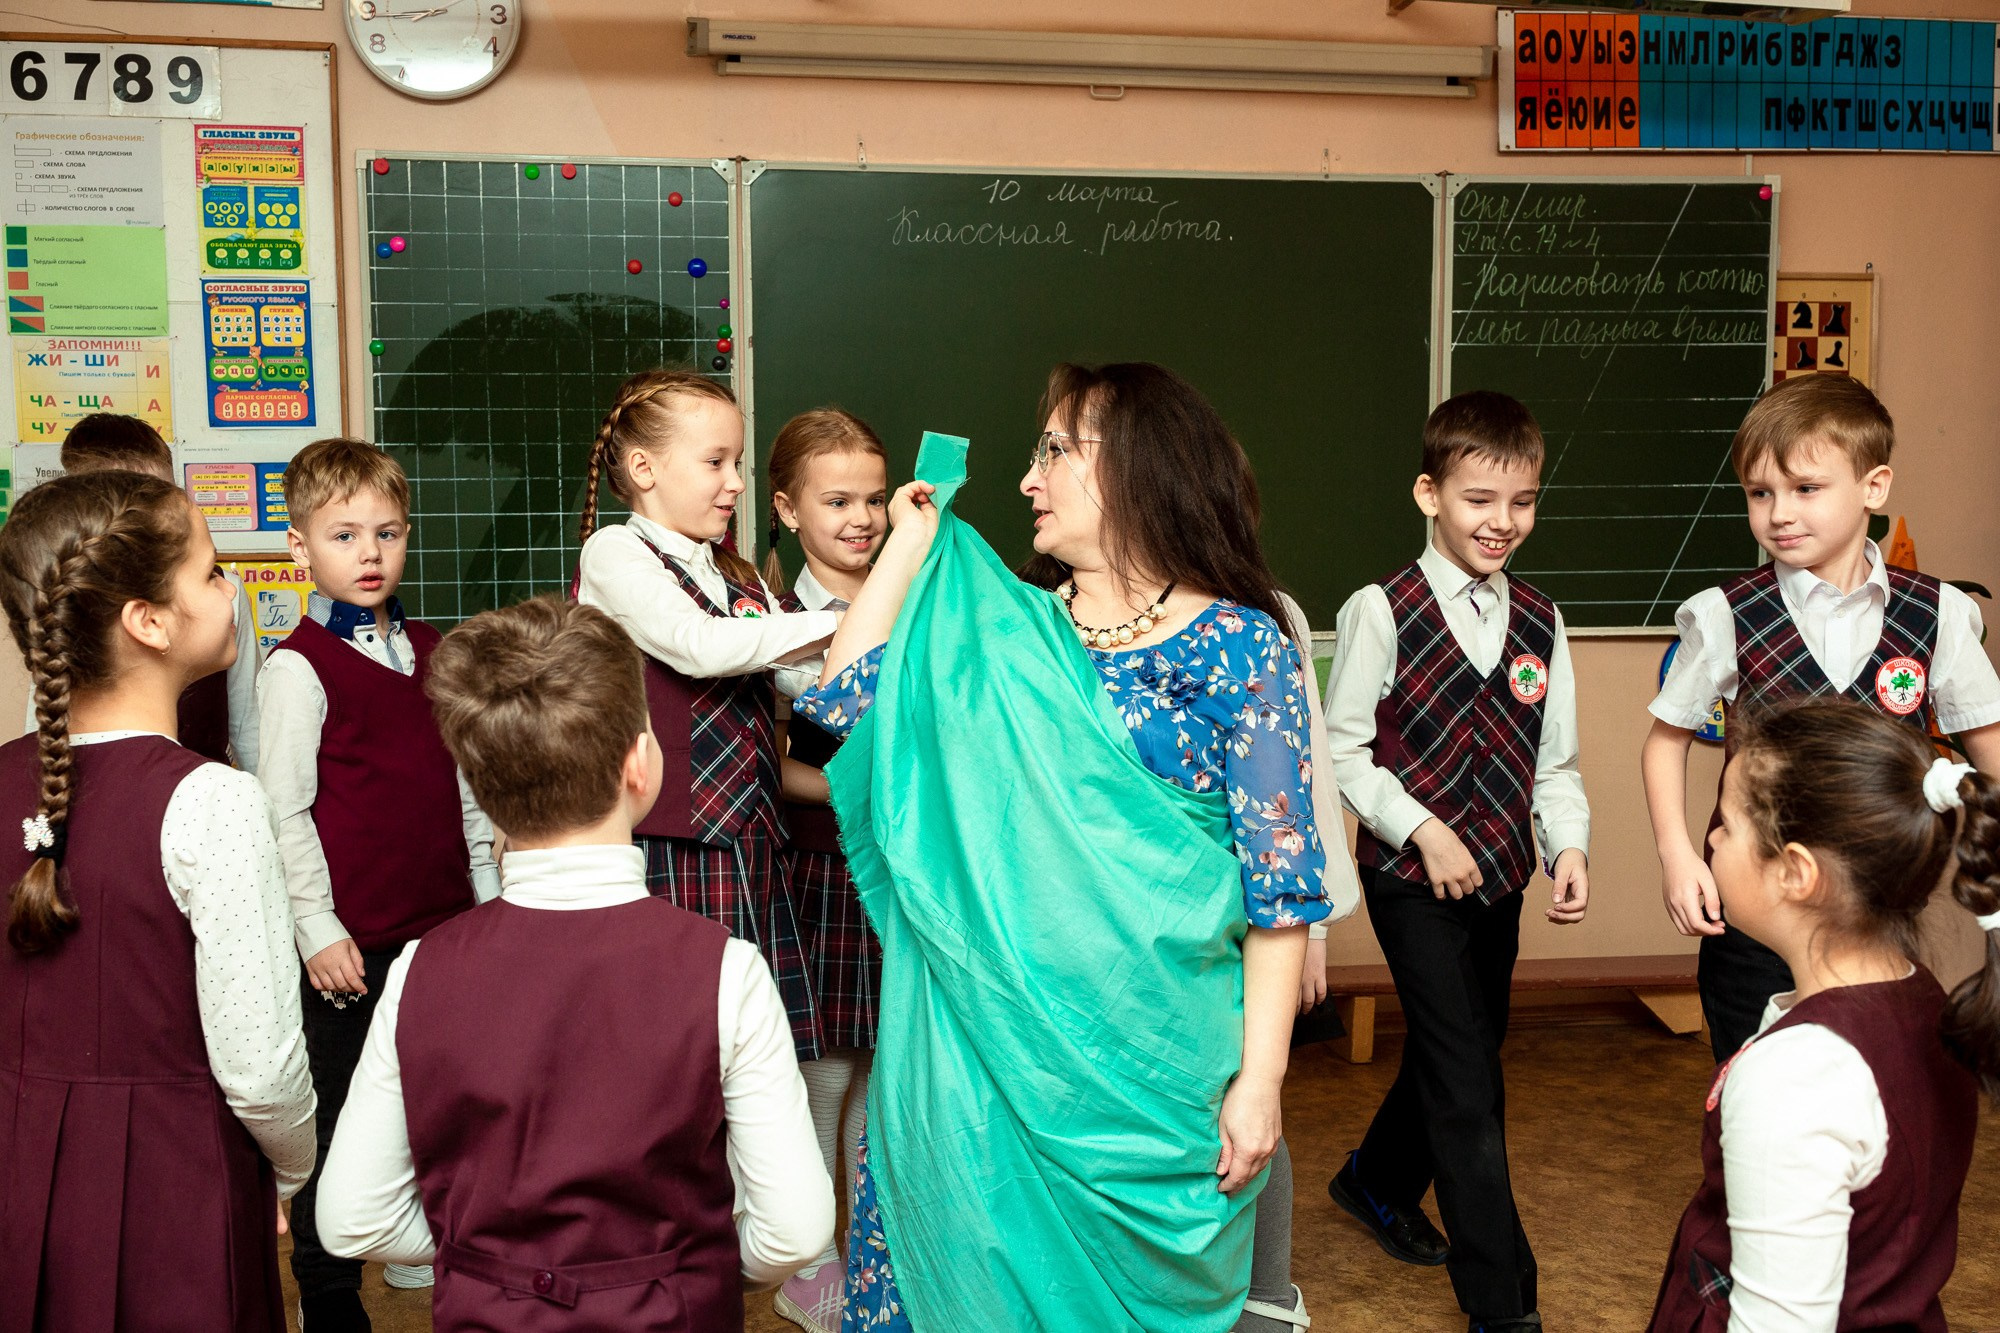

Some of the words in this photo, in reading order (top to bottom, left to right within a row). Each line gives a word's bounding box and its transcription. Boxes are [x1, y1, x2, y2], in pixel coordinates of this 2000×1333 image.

[490, 4, 508, 25] 3
[369, 33, 386, 53] 8
[483, 36, 499, 57] 4
[10, 50, 48, 101] 6
[64, 52, 101, 101] 7
[113, 53, 154, 103] 8
[167, 56, 203, 105] 9
[15, 132, 76, 140] Графические
[80, 133, 144, 142] обозначения:
[258, 131, 295, 139] ЗВУКИ
[981, 179, 1021, 204] 10
[887, 206, 1075, 246] Классная
[1466, 318, 1529, 344] мы
[48, 339, 142, 350] ЗАПОМНИ!!!
[27, 354, 62, 367] ЖИ
[85, 354, 119, 367] ШИ
[146, 365, 160, 378] И
[30, 395, 57, 407] ЧА
[78, 395, 113, 410] ЩА
[147, 399, 161, 412] А
[31, 422, 57, 434] ЧУ
[1713, 710, 1722, 721] 6
